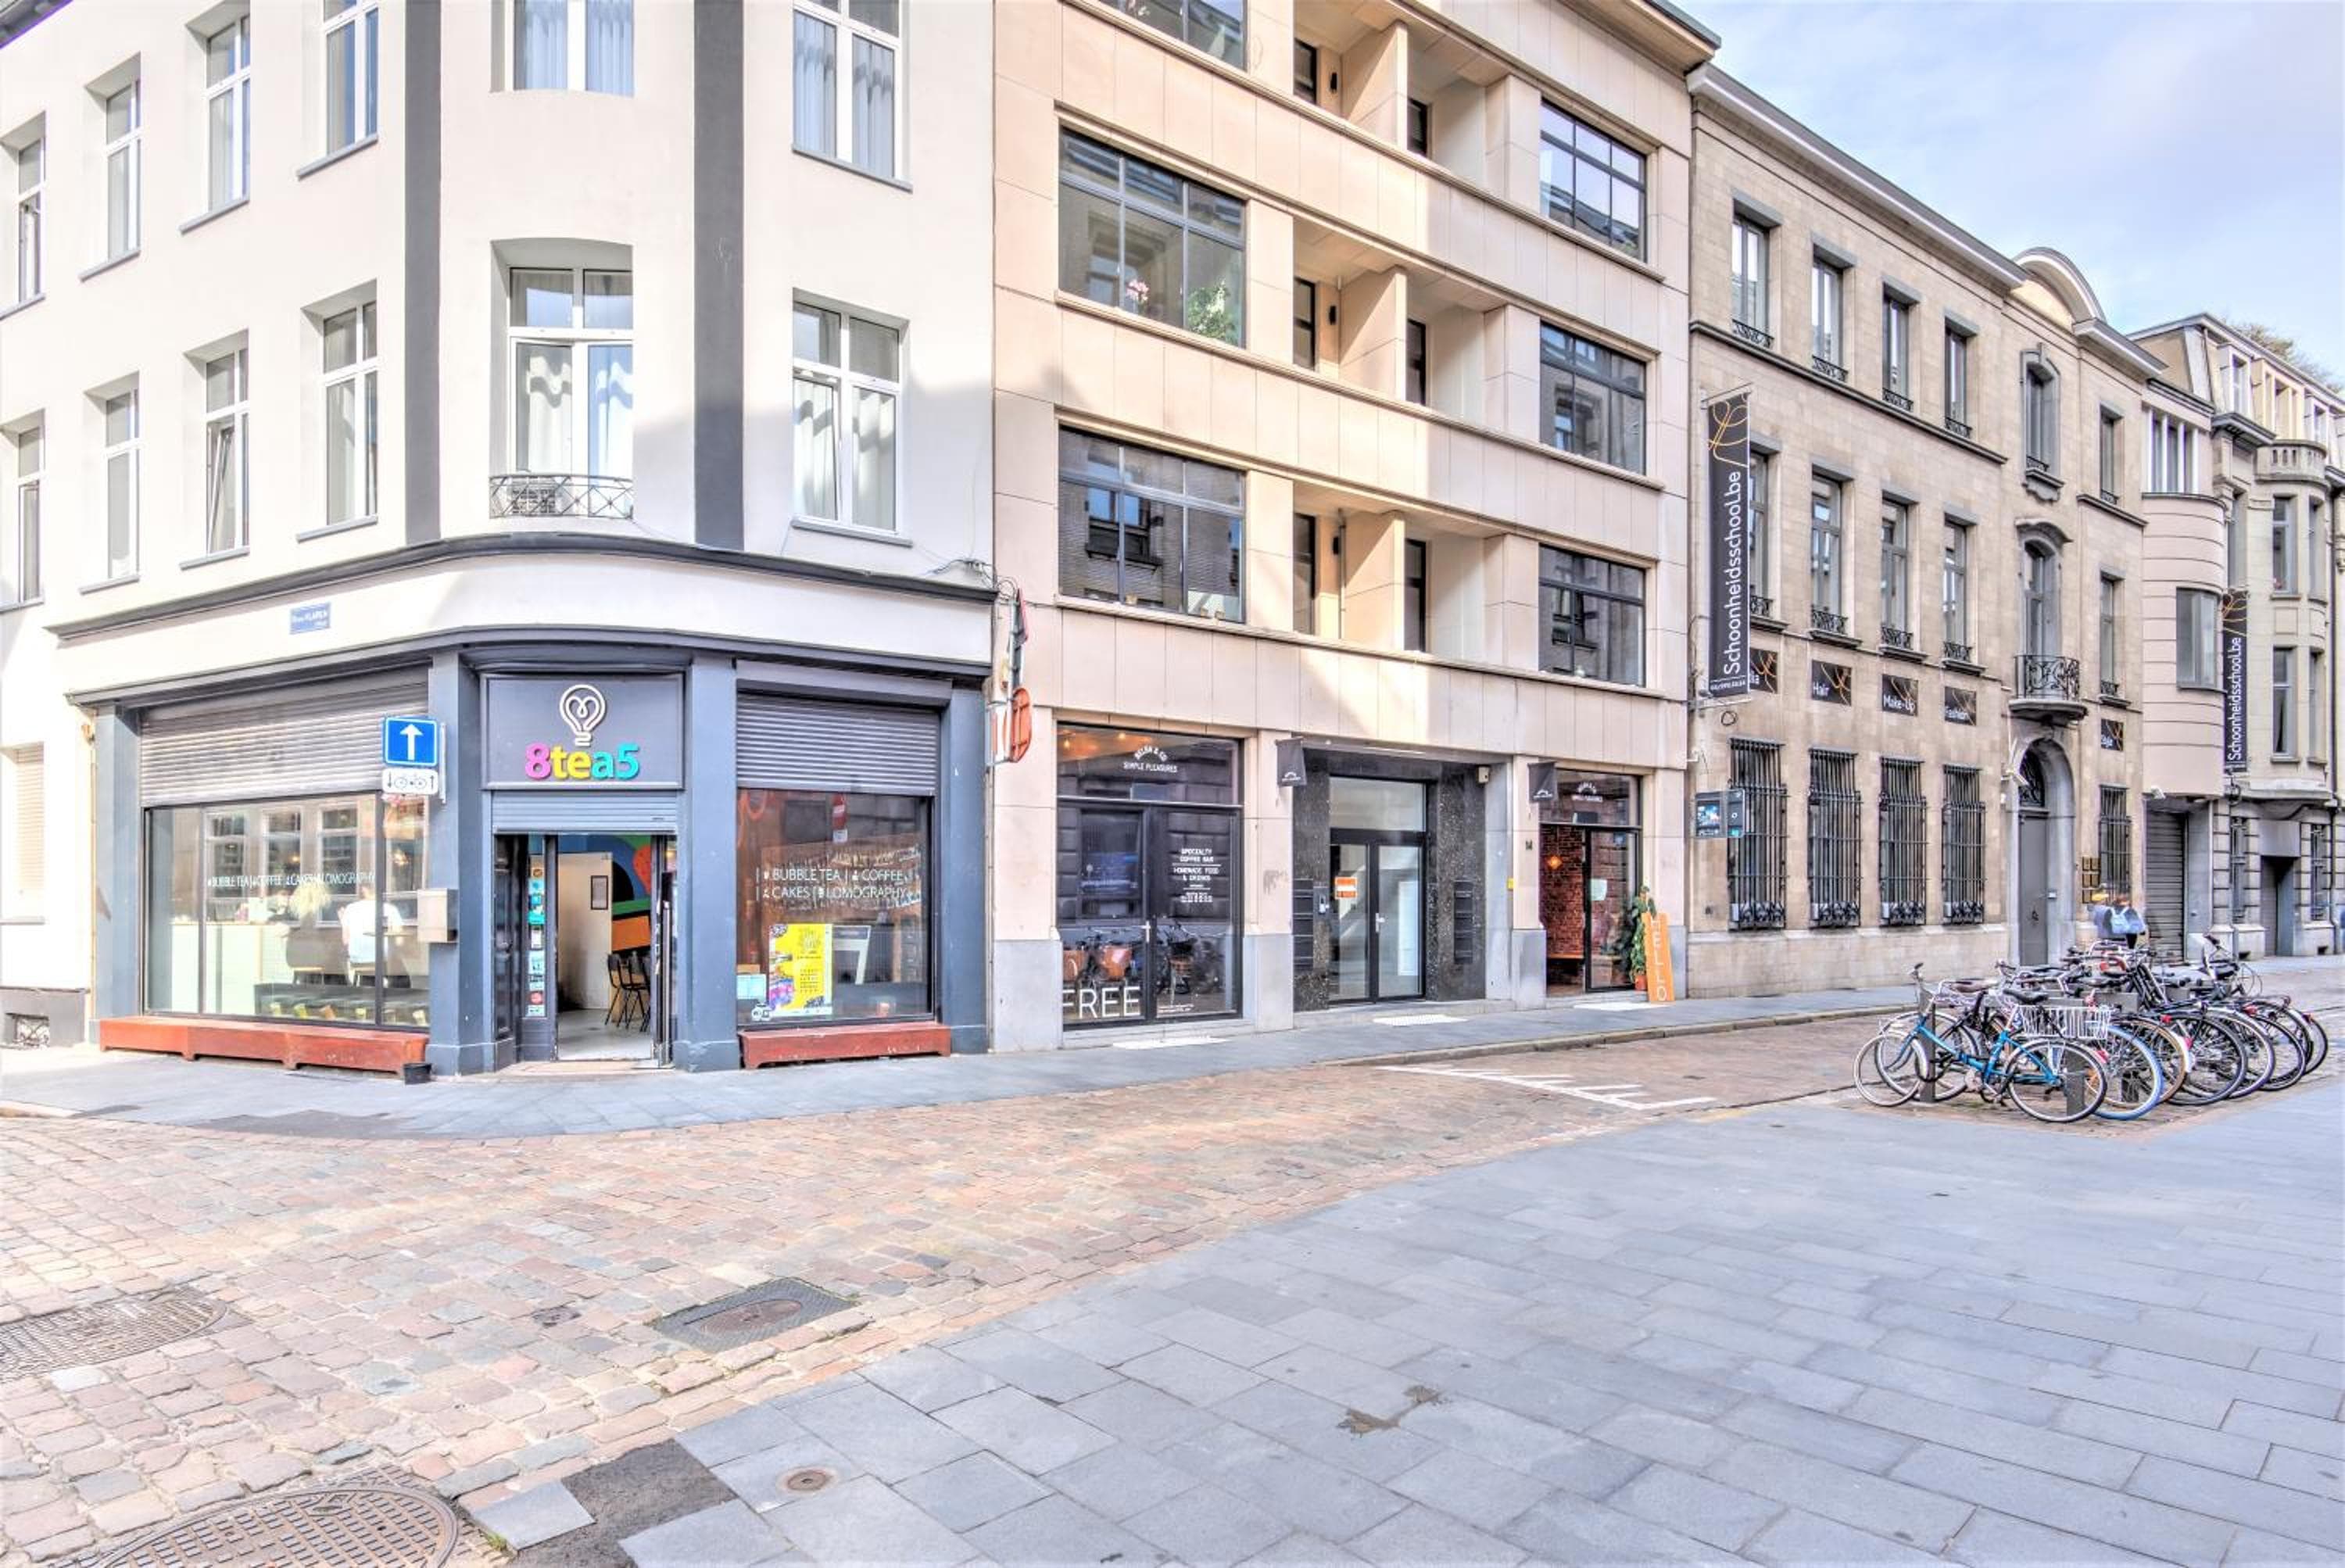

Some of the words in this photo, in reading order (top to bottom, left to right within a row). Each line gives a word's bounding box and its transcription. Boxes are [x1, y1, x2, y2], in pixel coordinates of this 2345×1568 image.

[1813, 681, 1830, 697] Hair
[1883, 693, 1915, 714] Make-Up
[524, 743, 640, 780] 8tea5
[772, 868, 818, 882] BUBBLE
[818, 868, 841, 882] TEA
[861, 868, 904, 882] COFFEE
[771, 885, 810, 899] CAKES
[825, 886, 908, 900] LOMOGRAPHY
